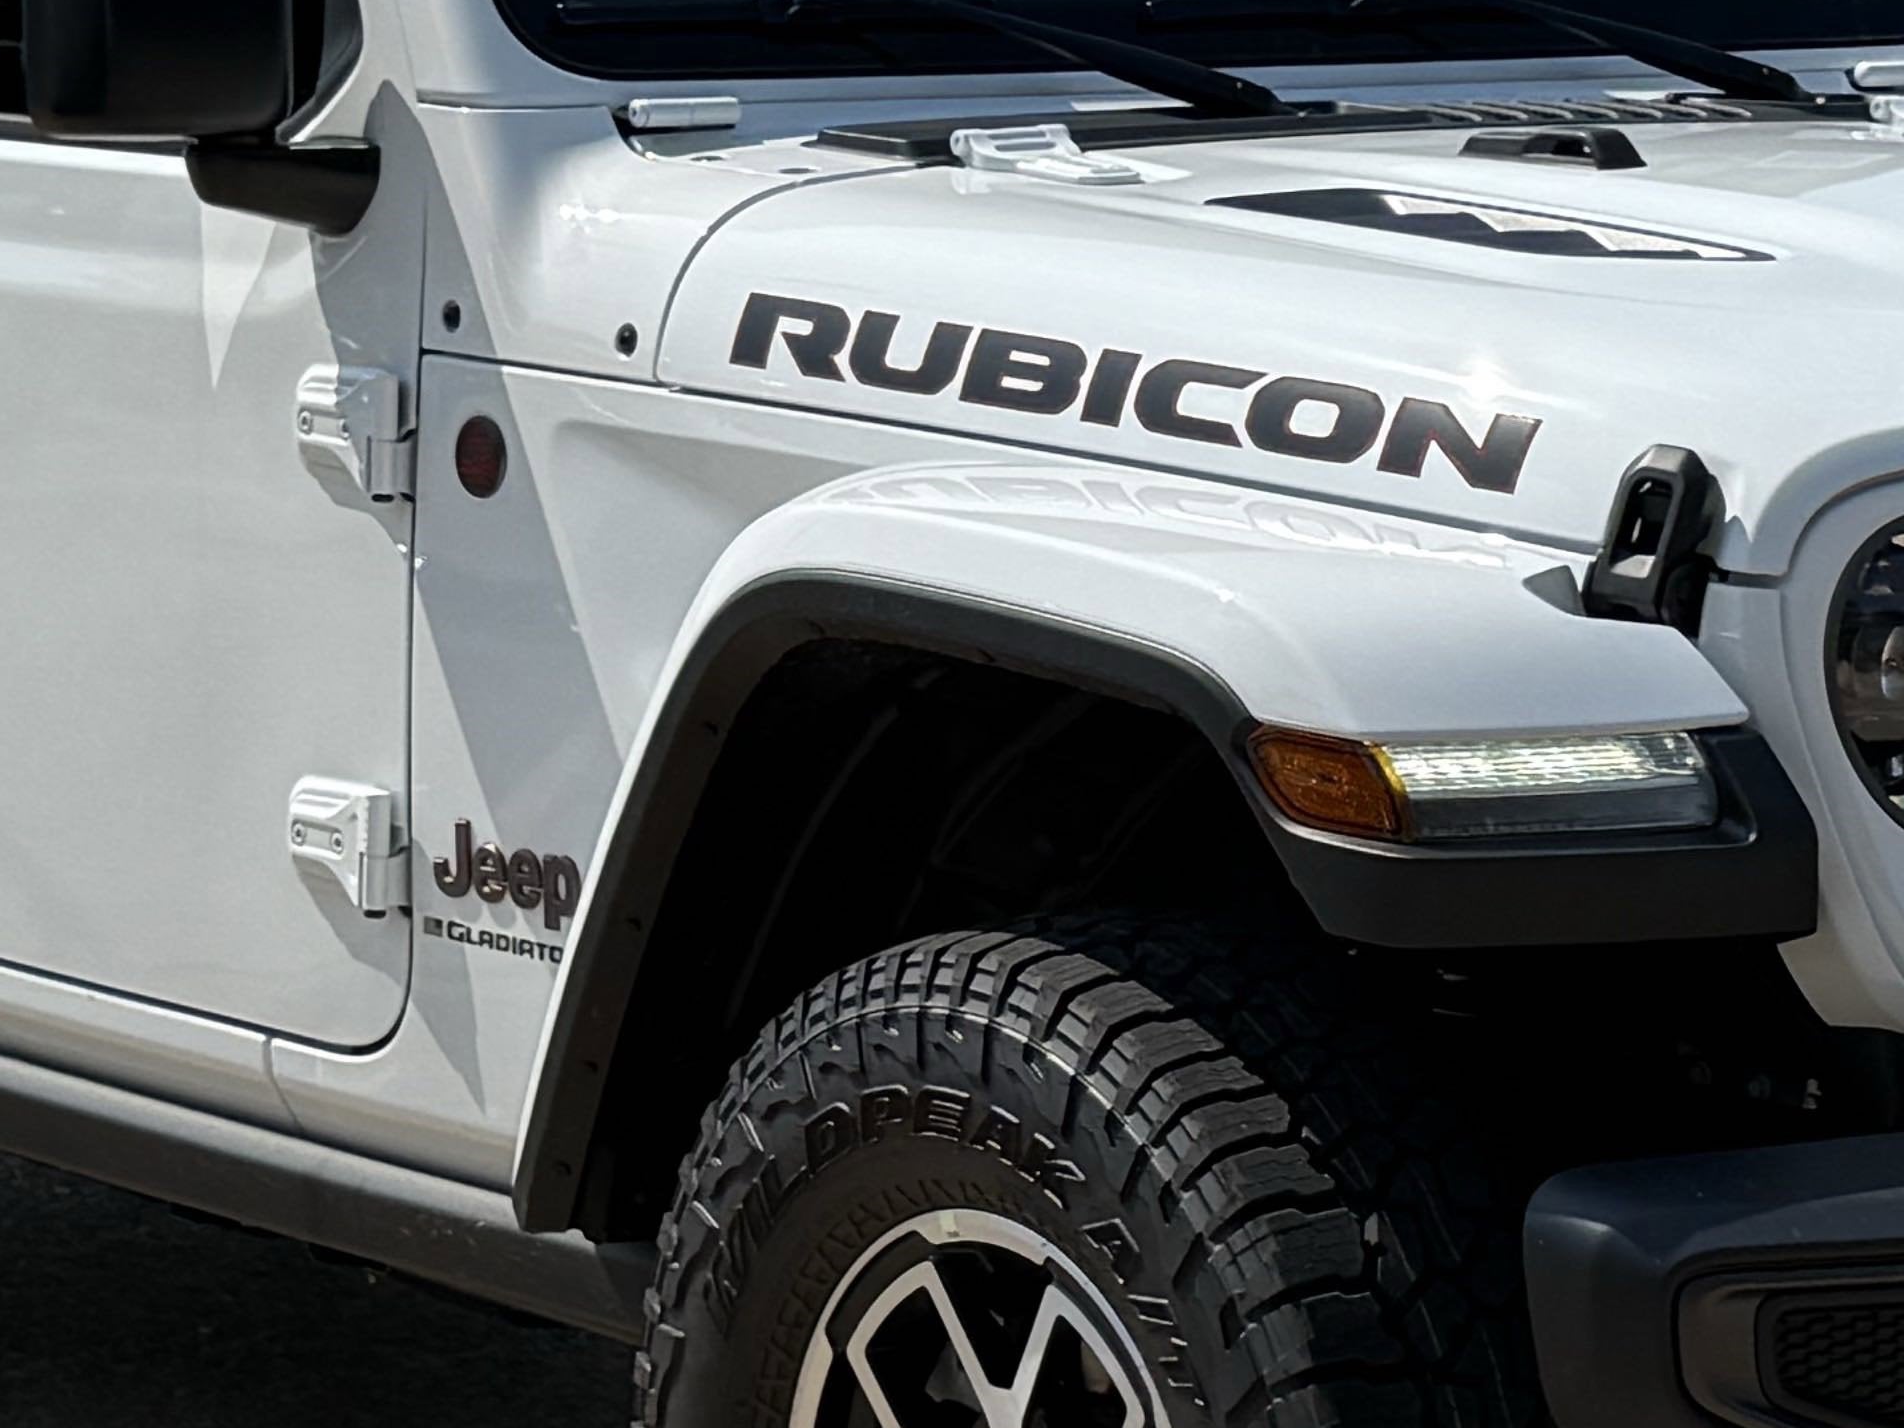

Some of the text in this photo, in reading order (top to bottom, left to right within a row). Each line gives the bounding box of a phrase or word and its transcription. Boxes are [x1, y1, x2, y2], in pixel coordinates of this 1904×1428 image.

[729, 291, 1542, 494] RUBICON
[433, 818, 582, 931] Jeep
[447, 920, 563, 963] GLADIATO
